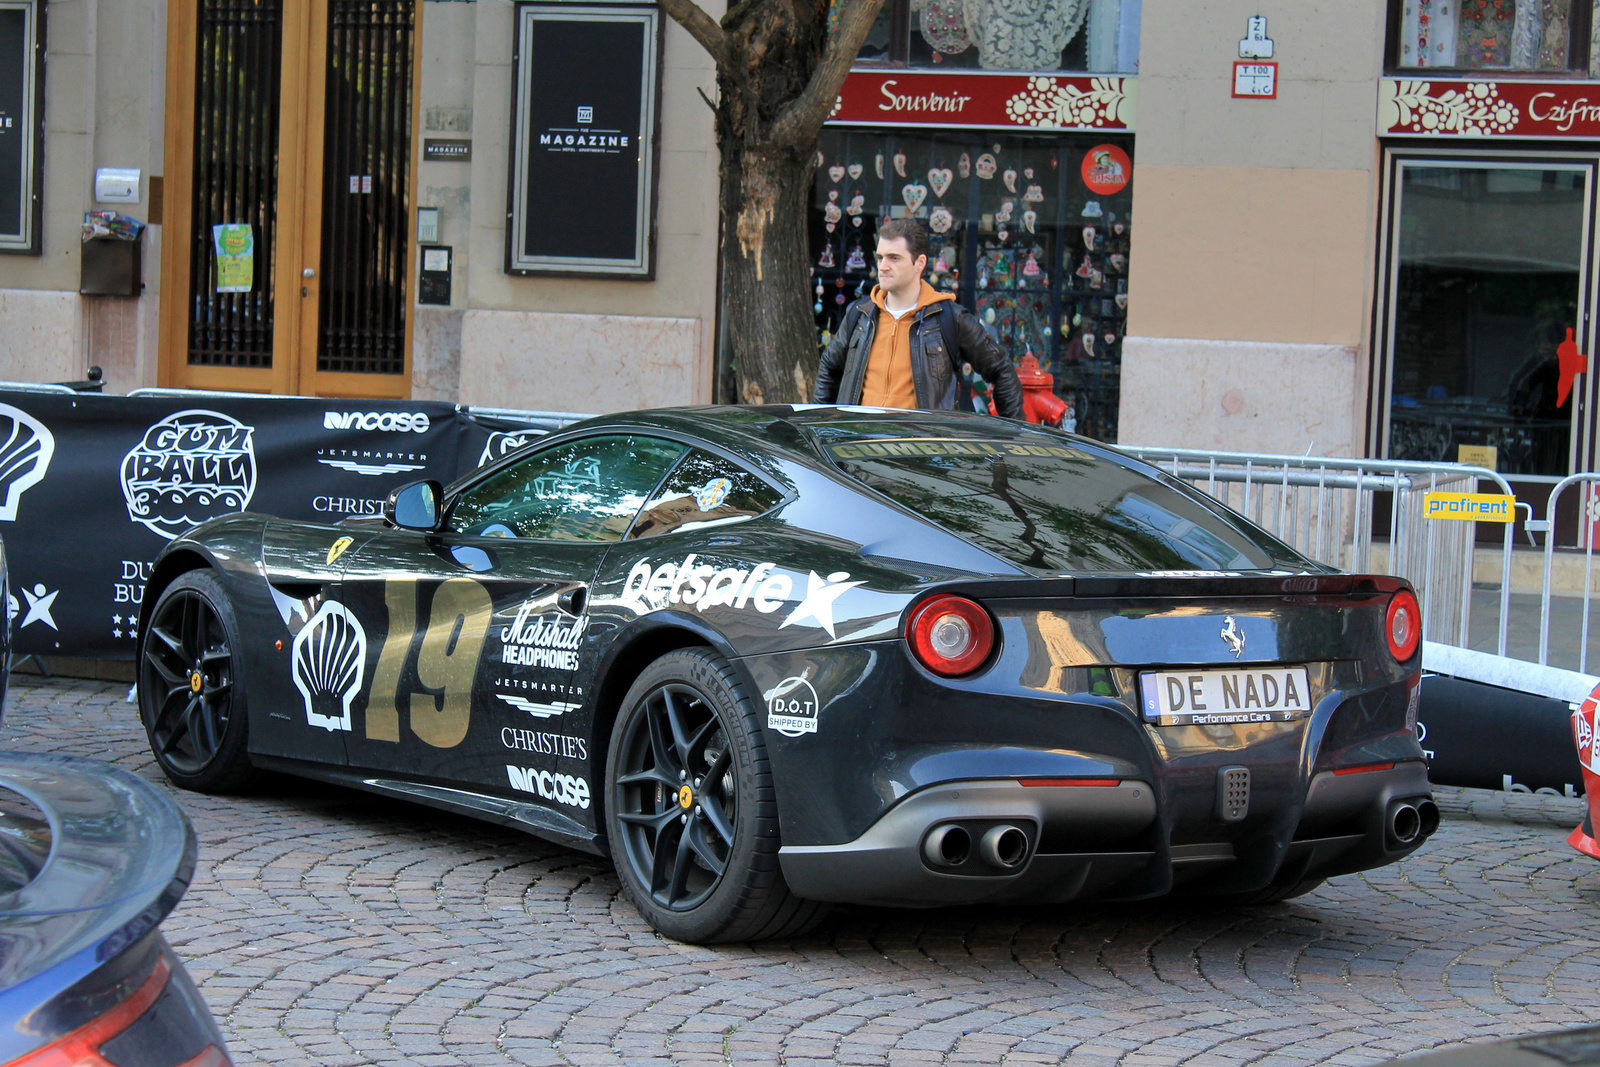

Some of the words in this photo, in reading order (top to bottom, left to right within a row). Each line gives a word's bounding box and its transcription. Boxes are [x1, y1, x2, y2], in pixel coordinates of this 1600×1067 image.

[1243, 66, 1249, 74] T
[1253, 66, 1268, 74] 100
[878, 79, 972, 112] Souvenir
[1528, 91, 1600, 131] Czifra
[540, 134, 628, 146] MAGAZINE
[338, 411, 430, 433] incase
[143, 419, 254, 454] GUM
[317, 448, 427, 461] JETSMARTER
[831, 441, 1006, 459] GUMBALL
[1004, 444, 1096, 461] 3000
[127, 451, 248, 491] BALL
[127, 485, 245, 526] 3000
[312, 495, 387, 514] CHRIST
[1429, 498, 1507, 514] profirent
[620, 553, 793, 614] betsafe
[501, 600, 589, 650] Marshall
[365, 578, 493, 748] 19
[502, 645, 580, 672] HEADPHONES
[495, 678, 583, 695] JETSMARTER
[1166, 675, 1207, 712] DE
[1221, 673, 1301, 709] NADA
[775, 698, 813, 715] D.O.T
[1148, 700, 1155, 710] S
[769, 717, 803, 728] SHIPPED
[804, 720, 816, 729] BY
[1192, 712, 1249, 724] Performance
[1250, 712, 1271, 721] Cars
[501, 726, 588, 760] CHRISTIE'S
[518, 766, 590, 810] incase
